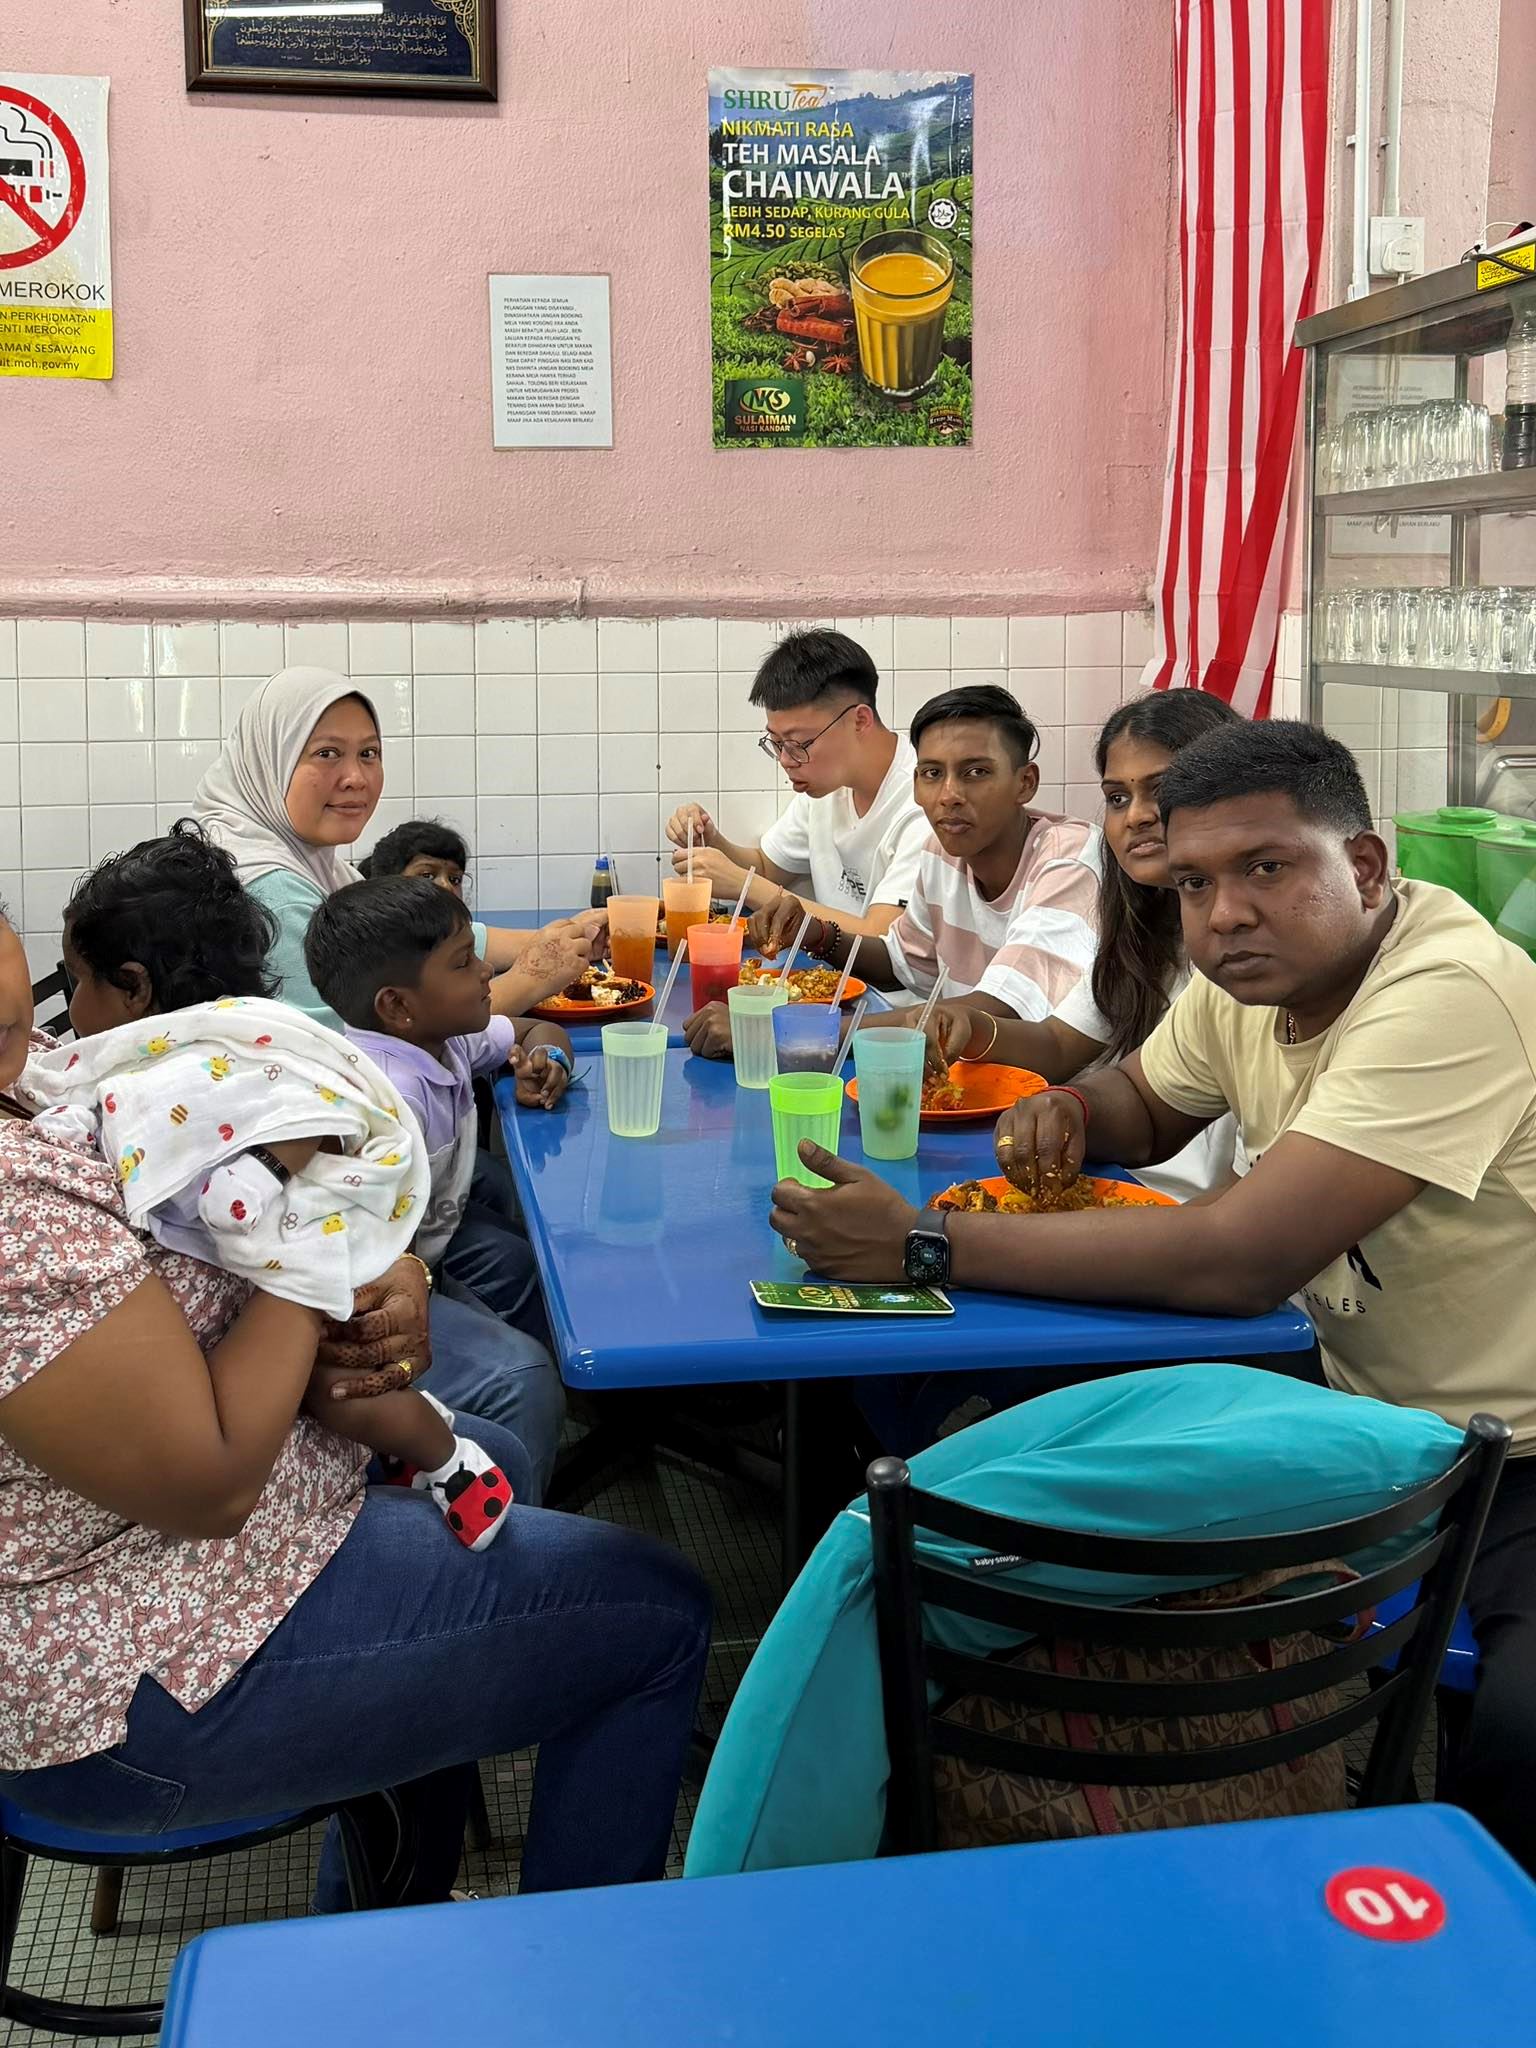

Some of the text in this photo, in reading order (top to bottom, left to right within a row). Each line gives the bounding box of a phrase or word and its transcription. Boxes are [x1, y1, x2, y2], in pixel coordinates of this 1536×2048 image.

[722, 120, 854, 138] NIKMATI RASA
[723, 143, 881, 166] TEH MASALA
[765, 206, 812, 220] SEDAP,
[815, 206, 870, 219] KURANG
[874, 206, 911, 219] GULA
[724, 224, 846, 239] RM4.50 SEGELAS
[0, 281, 106, 301] MEROKOK
[10, 312, 96, 323] PERKHIDMATAN
[25, 325, 81, 336] MEROKOK
[35, 344, 96, 355] SESAWANG
[734, 414, 797, 425] SULAIMAN
[974, 1558, 994, 1566] baby
[1344, 1882, 1430, 1926] 10
